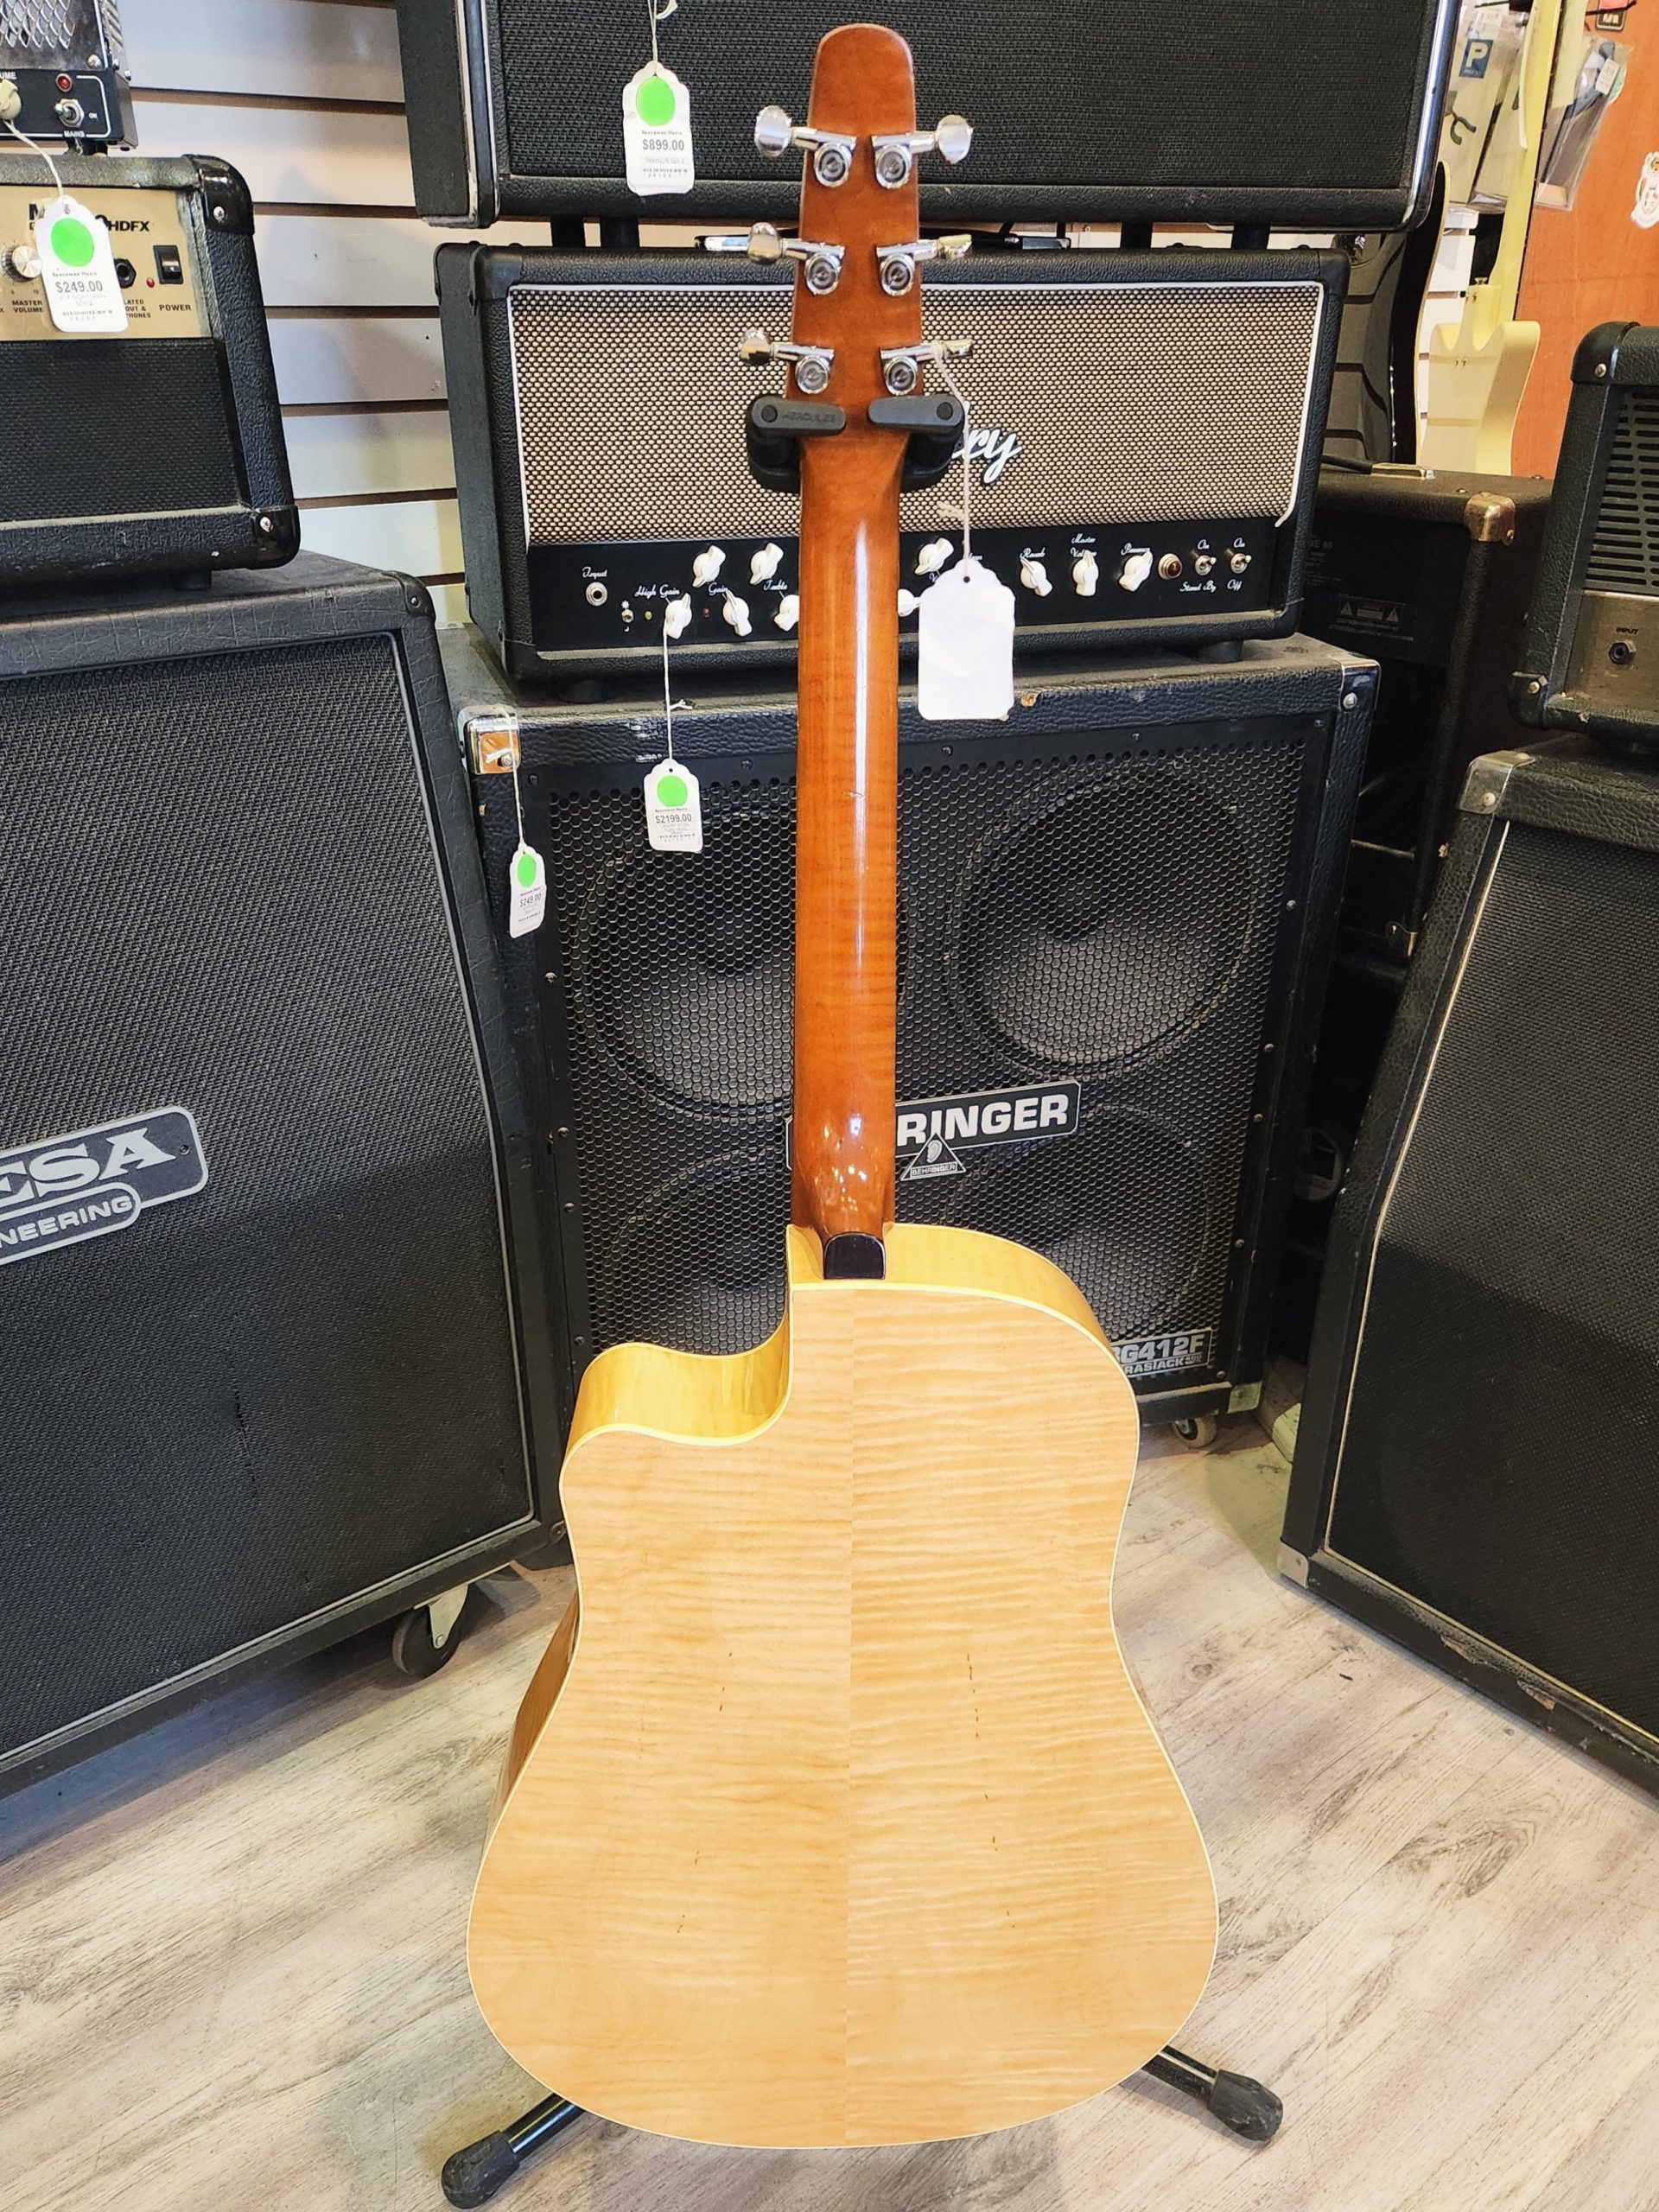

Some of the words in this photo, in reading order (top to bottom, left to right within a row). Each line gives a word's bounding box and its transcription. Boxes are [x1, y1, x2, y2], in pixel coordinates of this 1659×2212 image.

[642, 139, 684, 150] $899.00
[54, 280, 103, 293] $249.00
[1198, 539, 1210, 550] On
[1234, 537, 1246, 548] On
[582, 566, 607, 580] Input
[709, 582, 728, 596] Gain
[1227, 579, 1243, 591] Off
[634, 584, 657, 599] High
[659, 584, 680, 598] Gain
[655, 813, 692, 823] $2199.00
[897, 1094, 1070, 1147] RINGER
[912, 1164, 956, 1176] BEHRINGER
[1124, 1357, 1185, 1375] RASTACK
